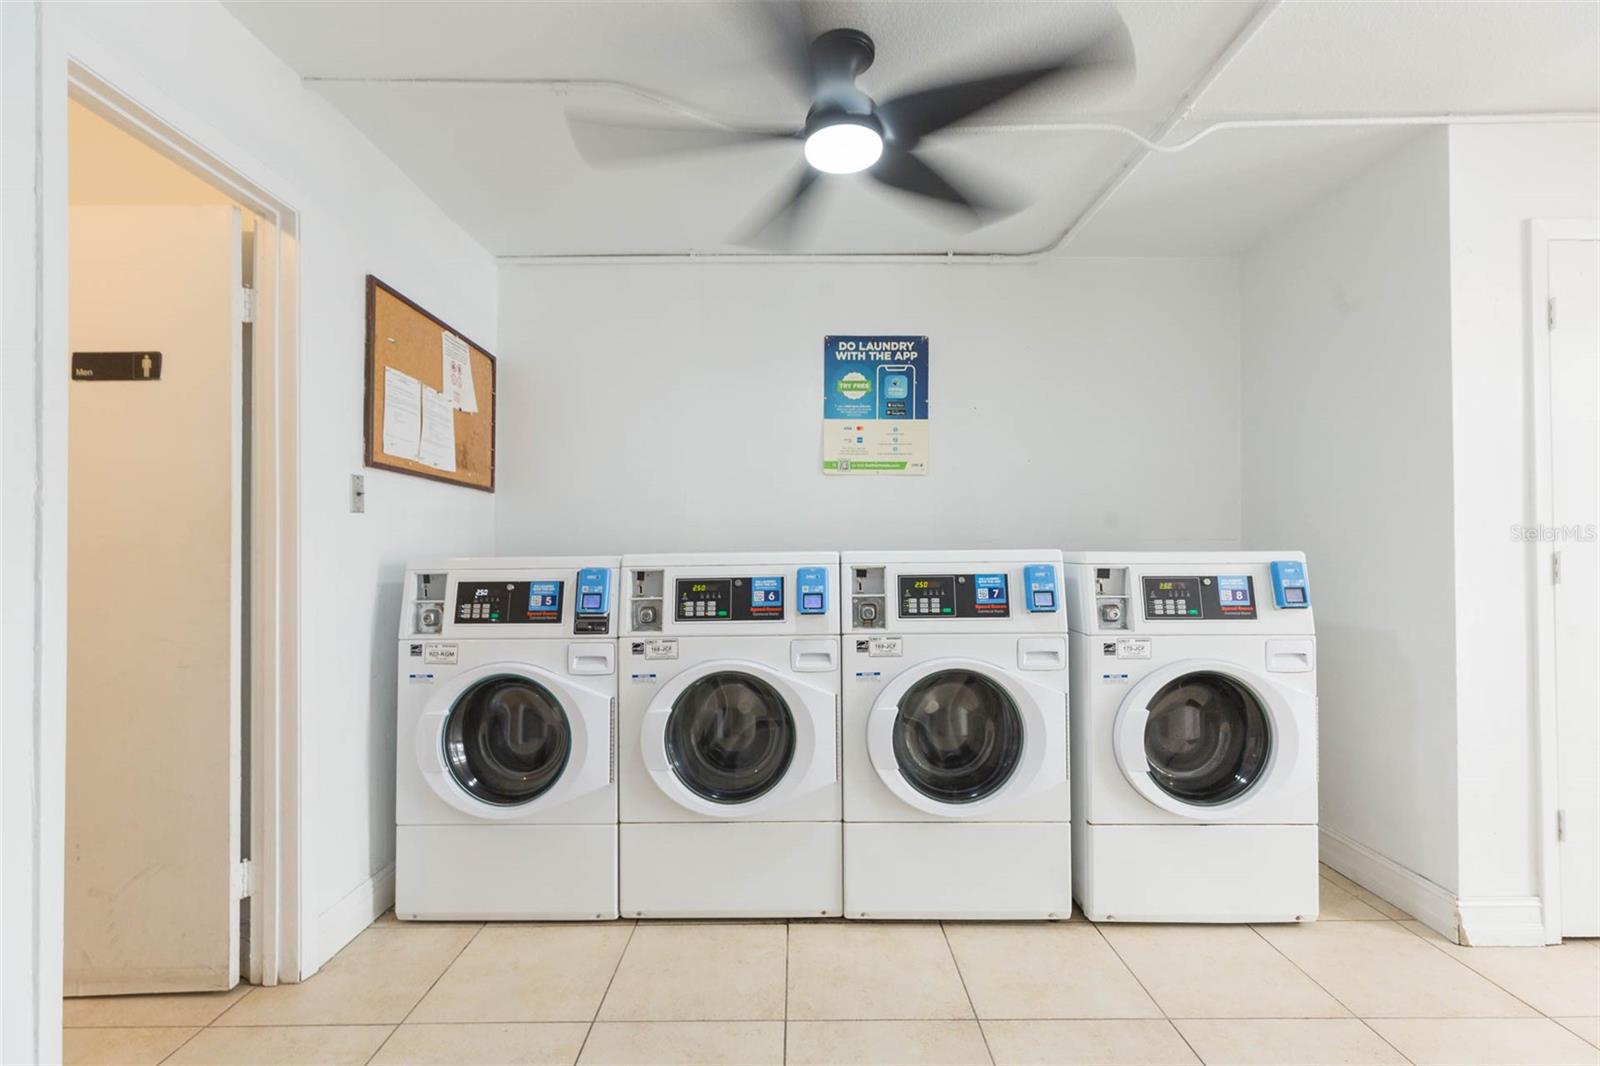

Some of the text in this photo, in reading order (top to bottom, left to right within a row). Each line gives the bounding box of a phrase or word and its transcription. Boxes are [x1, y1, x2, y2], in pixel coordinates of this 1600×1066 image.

[838, 342, 915, 351] DO LAUNDRY
[835, 351, 918, 361] WITH THE APP
[75, 368, 94, 377] Men
[692, 584, 706, 592] 250
[768, 591, 776, 601] 6
[992, 589, 999, 598] 7
[1236, 591, 1243, 600] 8
[545, 596, 552, 605] 5
